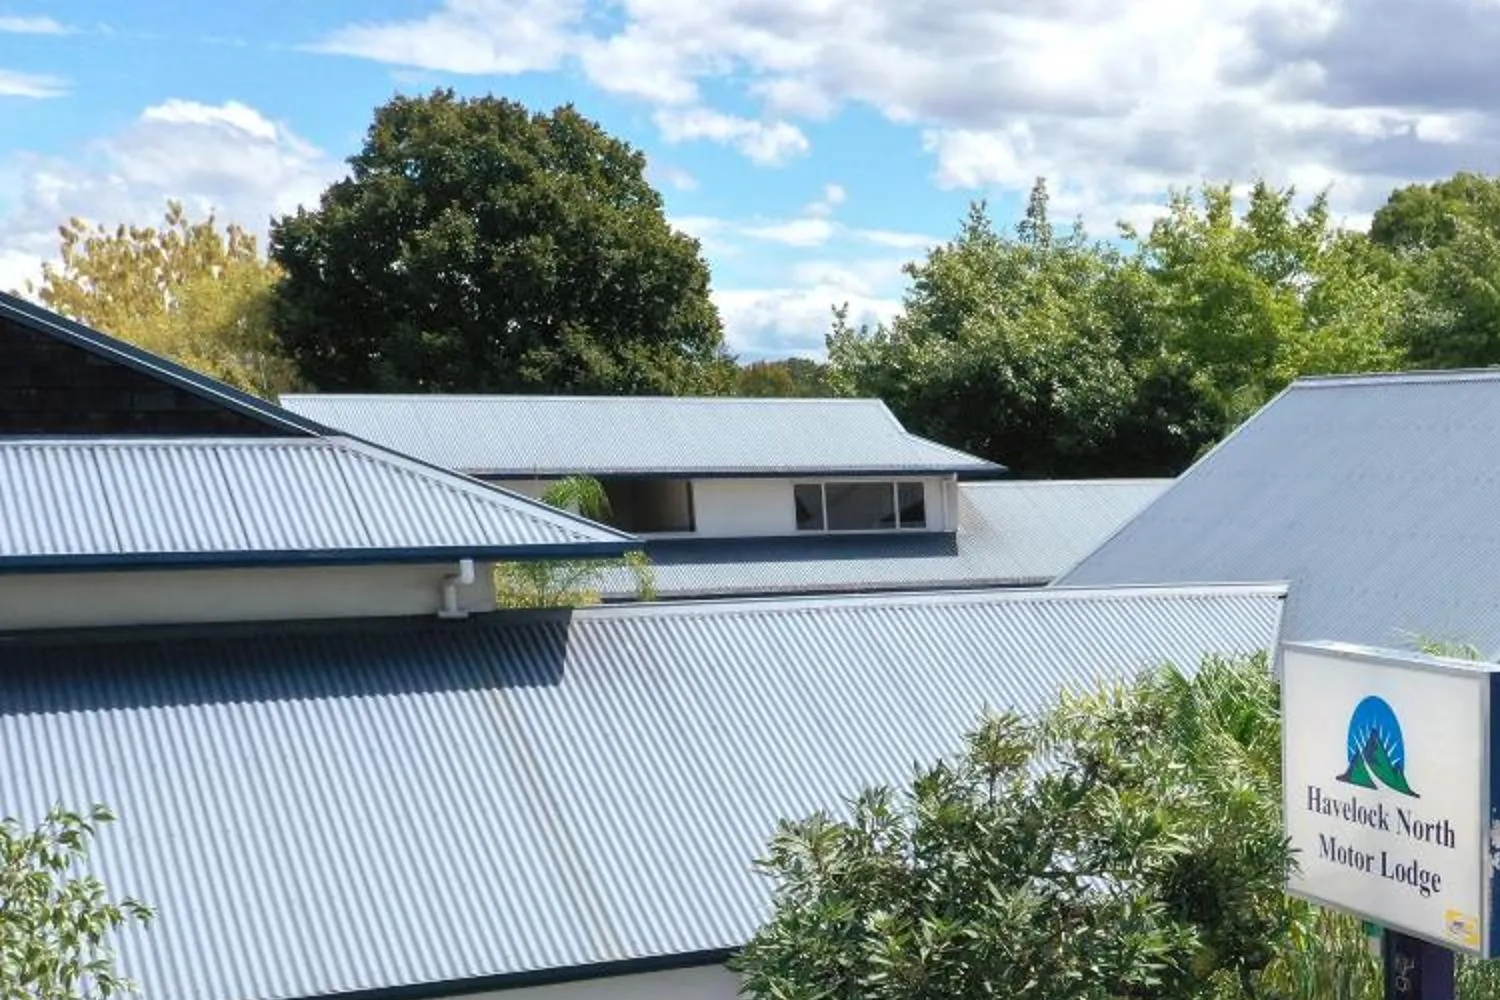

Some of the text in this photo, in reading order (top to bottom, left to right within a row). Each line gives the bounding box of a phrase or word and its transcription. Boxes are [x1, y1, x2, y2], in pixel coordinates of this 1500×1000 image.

[1307, 785, 1455, 849] Havelock North
[1319, 833, 1441, 898] Motor Lodge
